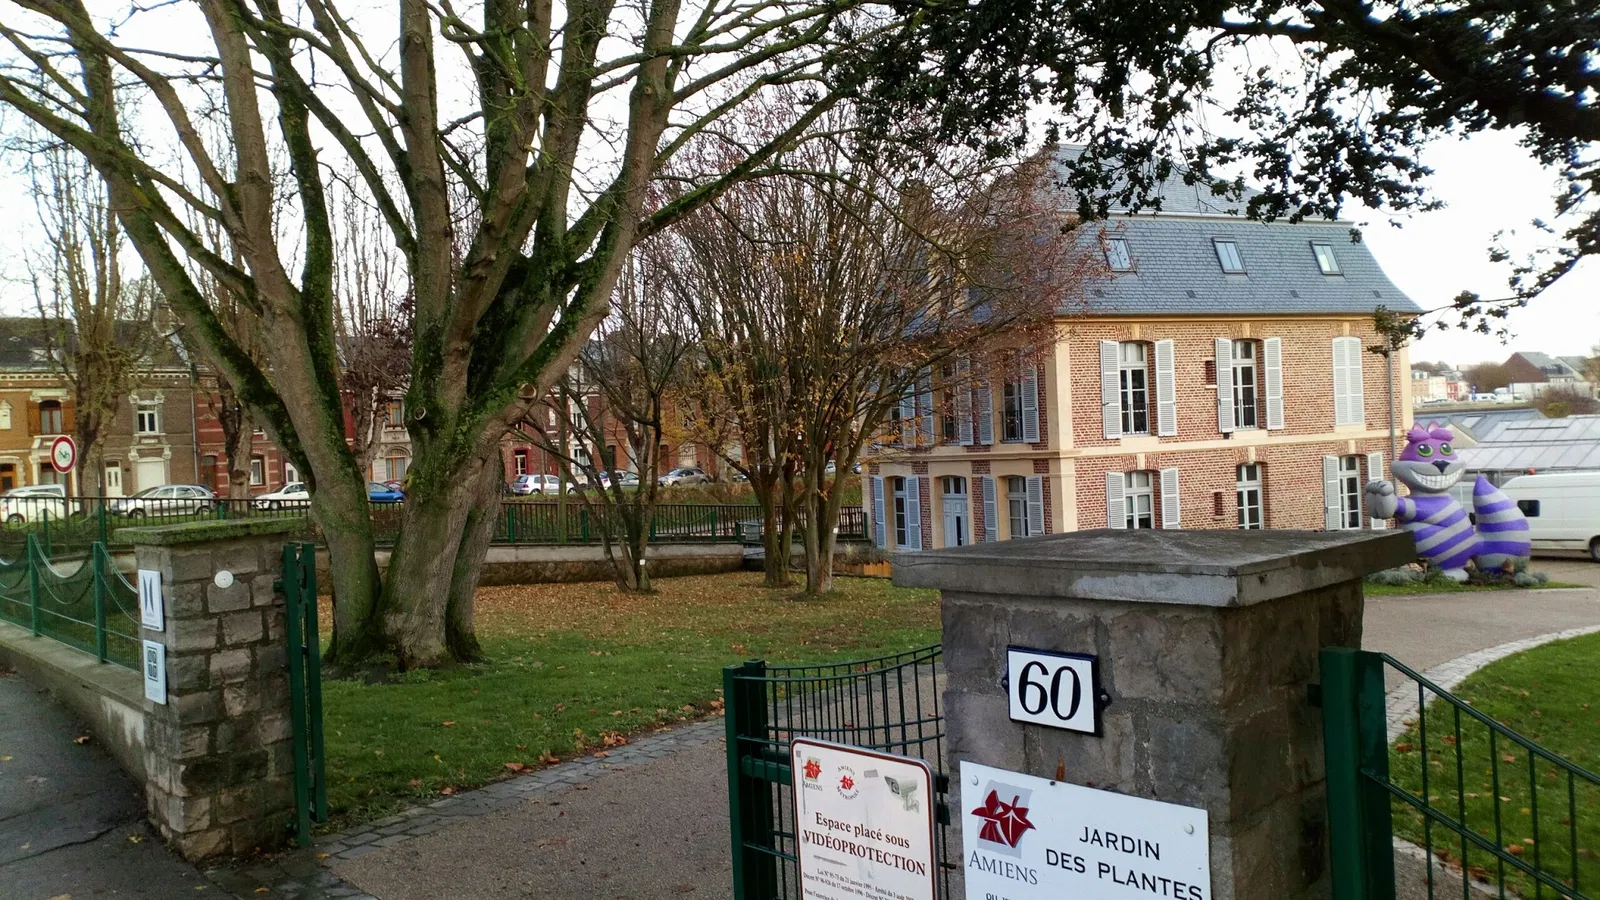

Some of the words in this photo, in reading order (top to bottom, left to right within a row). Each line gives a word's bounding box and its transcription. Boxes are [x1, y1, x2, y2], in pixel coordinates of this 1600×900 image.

[1018, 660, 1081, 721] 60
[803, 781, 823, 792] AMIENS
[815, 812, 851, 833] Espace
[854, 823, 882, 841] placé
[885, 833, 910, 849] sous
[1079, 826, 1161, 861] JARDIN
[803, 829, 926, 877] VIDÉOPROTECTION
[969, 850, 1038, 886] AMIENS
[1046, 848, 1086, 874] DES
[1097, 861, 1203, 900] PLANTES
